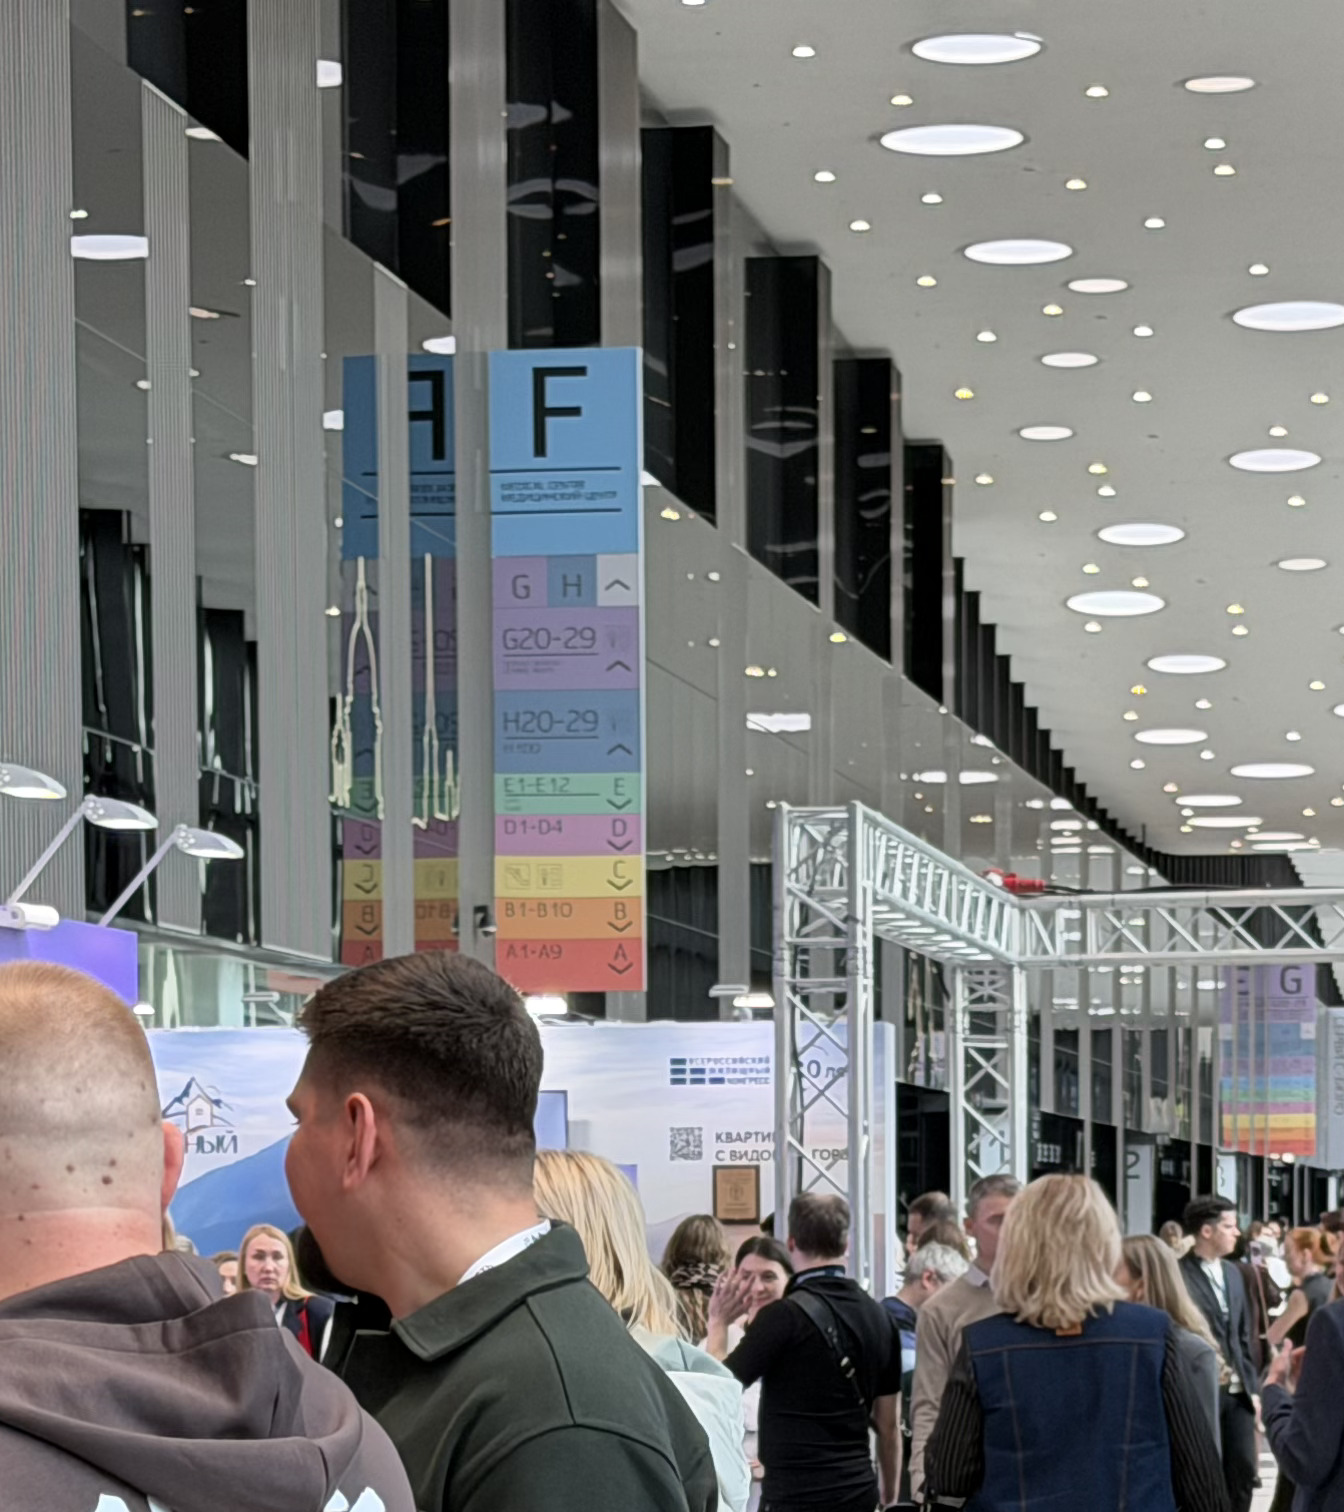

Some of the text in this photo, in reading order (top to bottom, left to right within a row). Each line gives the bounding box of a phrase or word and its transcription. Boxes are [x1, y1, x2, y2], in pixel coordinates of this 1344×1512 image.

[532, 366, 588, 458] F
[511, 574, 583, 600] G H
[503, 627, 597, 651] G20-29
[503, 710, 599, 734] H20-29
[504, 777, 626, 796] E1-E12 E
[504, 818, 628, 836] D1-D4 D
[613, 861, 627, 880] C
[506, 902, 627, 921] B1-B10 B
[507, 944, 628, 962] A1-A9 A
[1279, 964, 1303, 995] G
[715, 1131, 775, 1144] КВАРТИ
[729, 1150, 775, 1163] ВИДО
